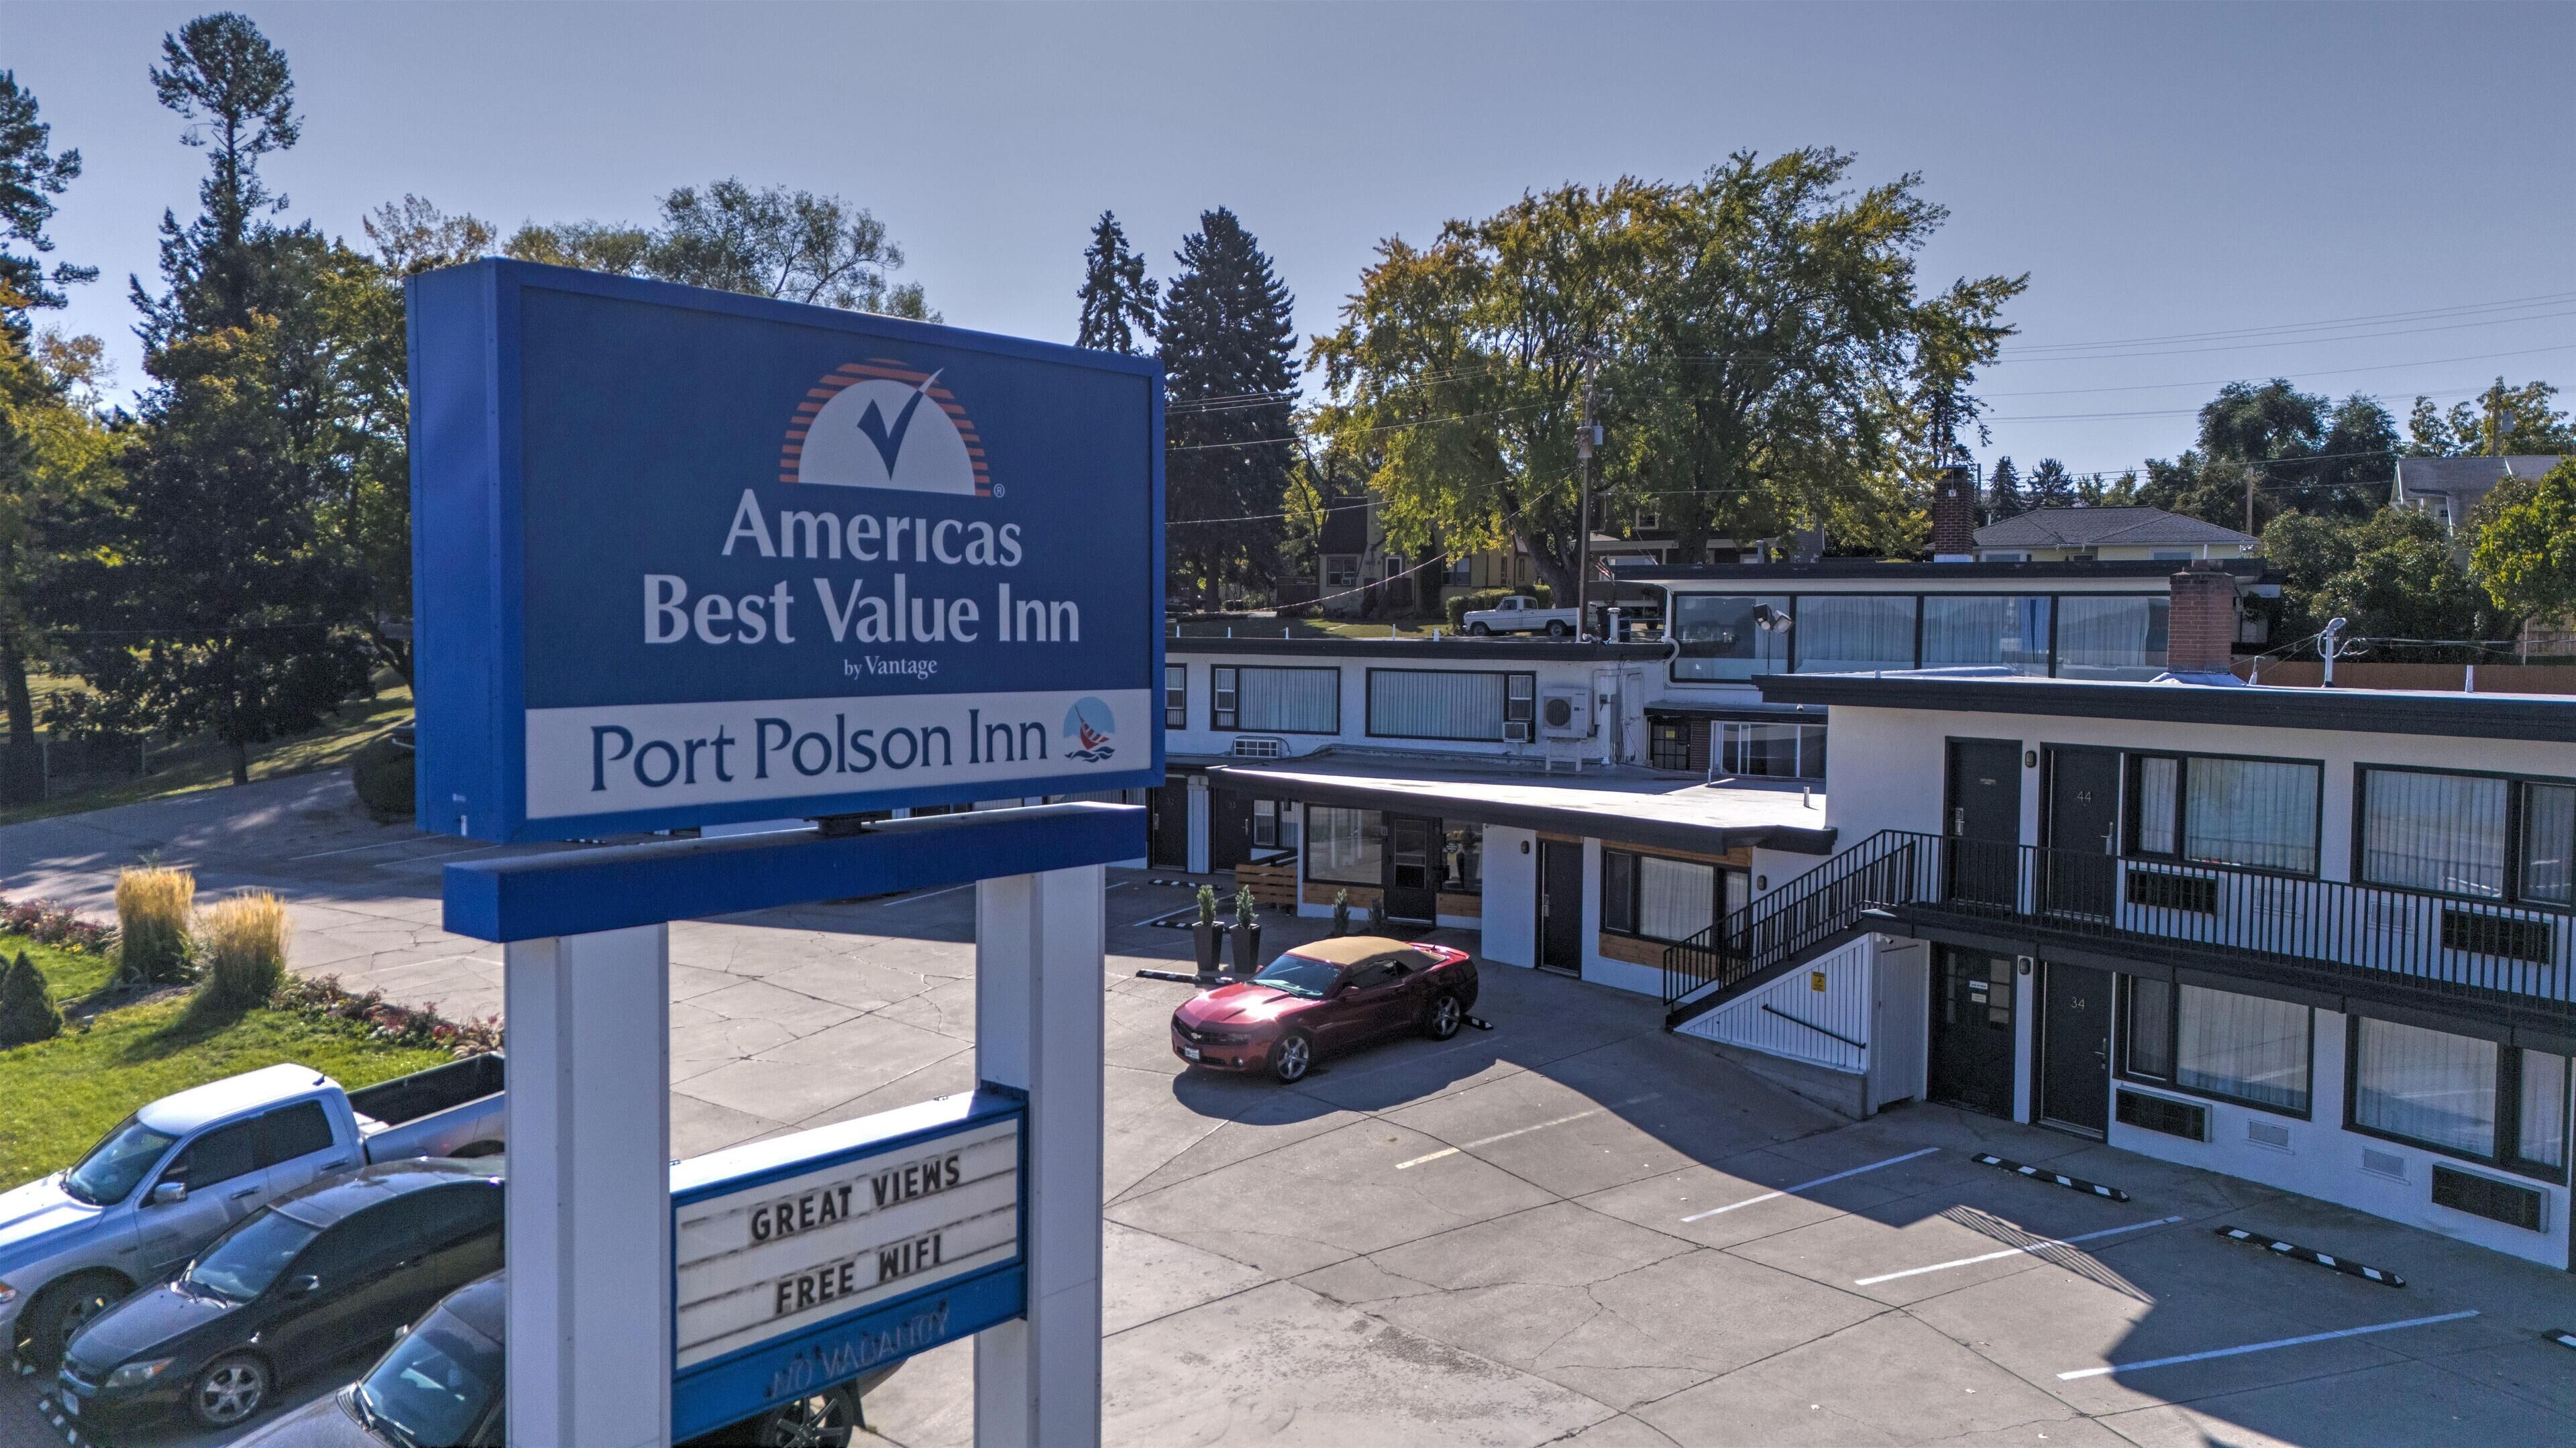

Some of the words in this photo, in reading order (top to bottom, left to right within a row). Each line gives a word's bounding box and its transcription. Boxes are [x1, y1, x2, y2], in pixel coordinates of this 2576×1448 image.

[722, 488, 1022, 567] Americas
[643, 574, 796, 645] Best
[813, 573, 979, 643] Value
[998, 583, 1080, 643] Inn
[844, 658, 862, 679] by
[865, 656, 938, 679] Vantage
[590, 725, 735, 792] Port
[755, 714, 951, 780] Polson
[969, 709, 1048, 765] Inn
[2077, 791, 2091, 803] 44
[2072, 997, 2084, 1009] 34
[752, 1186, 852, 1240] GREAT
[873, 1156, 959, 1207] VIEWS
[776, 1262, 854, 1315] FREE
[879, 1235, 941, 1280] WIFI
[773, 1359, 814, 1399] NO
[822, 1306, 949, 1380] VACANCY
